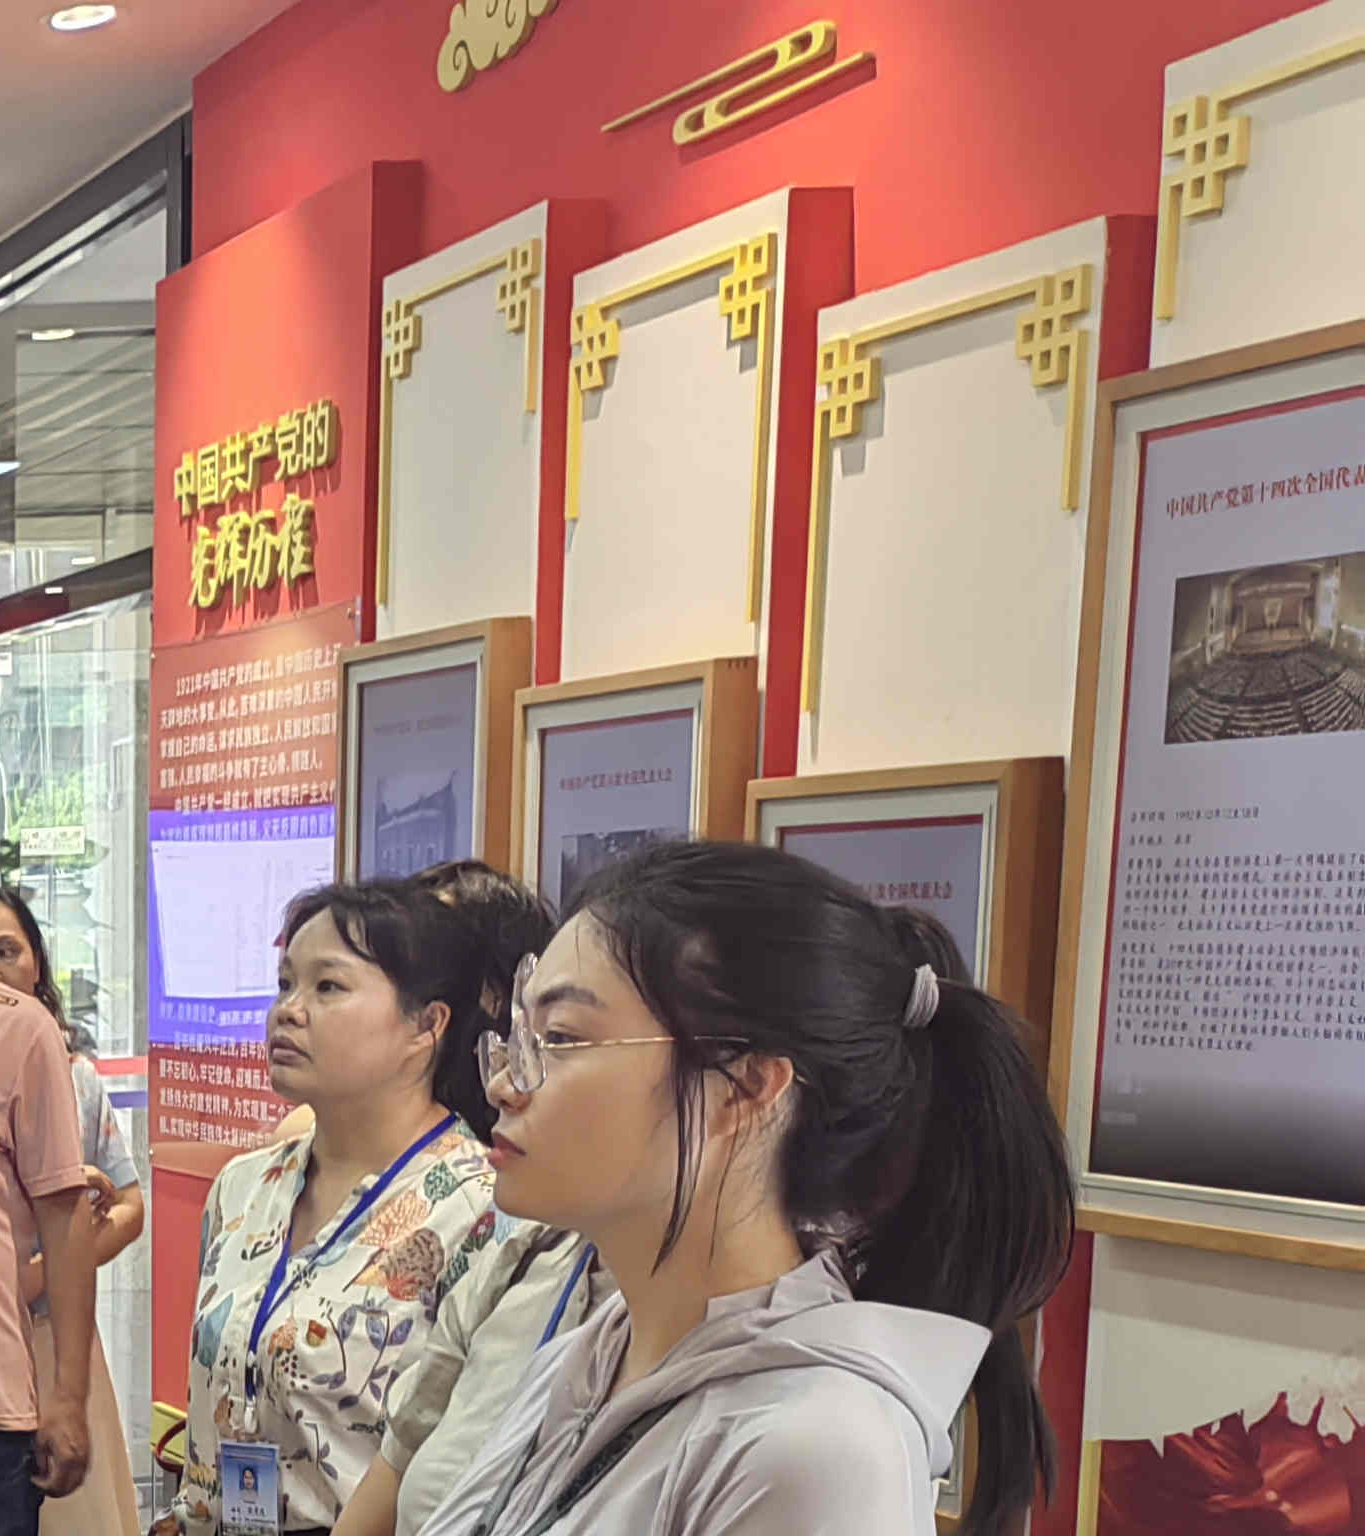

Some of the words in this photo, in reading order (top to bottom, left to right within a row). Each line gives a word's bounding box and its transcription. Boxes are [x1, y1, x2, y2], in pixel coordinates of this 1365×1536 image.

[173, 399, 335, 516] 中国共产党的
[189, 492, 316, 608] 光辉历程
